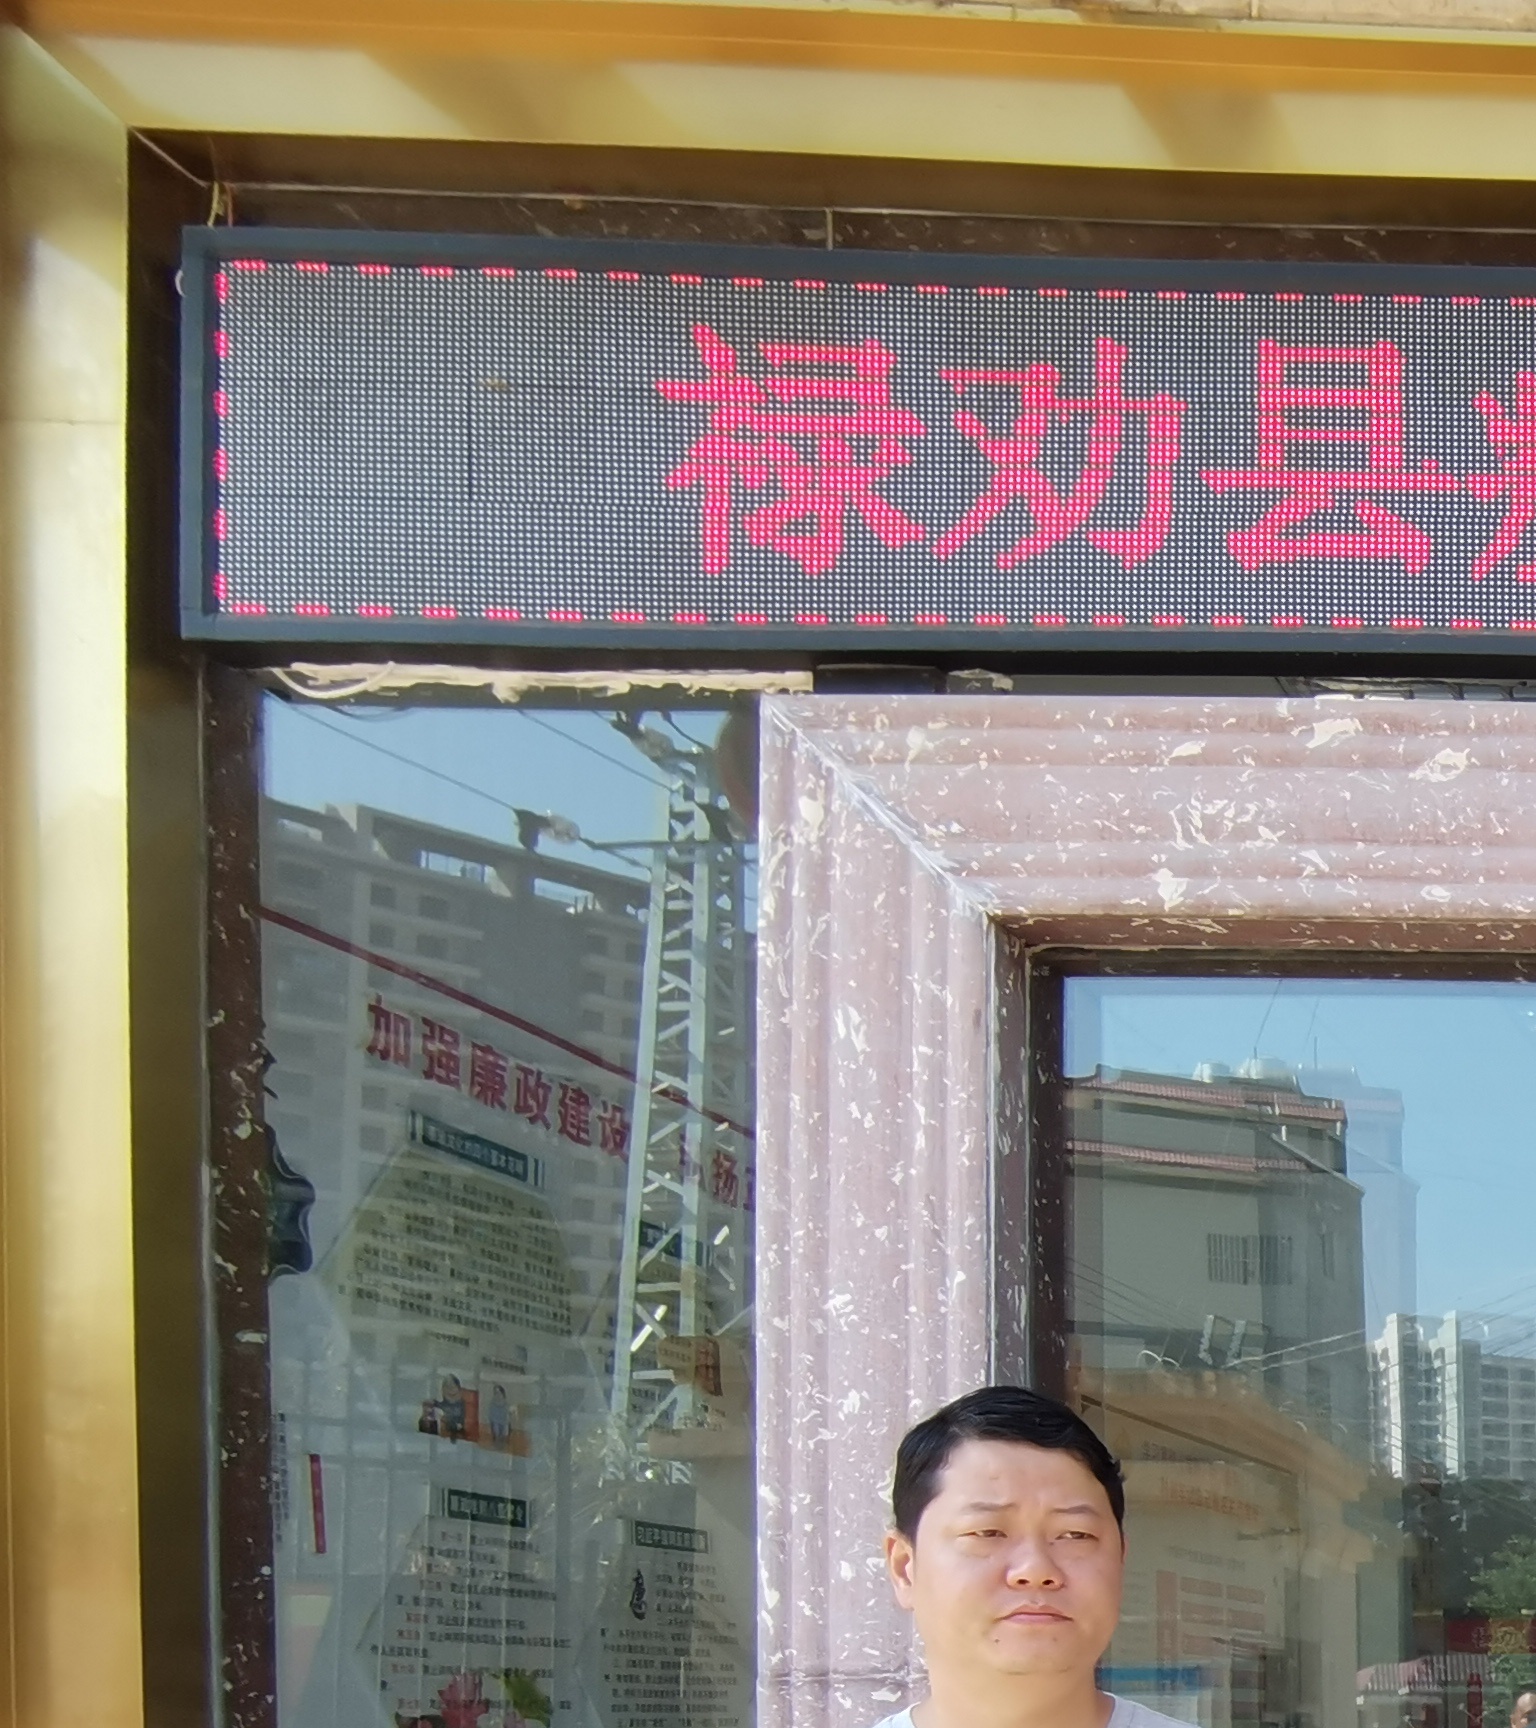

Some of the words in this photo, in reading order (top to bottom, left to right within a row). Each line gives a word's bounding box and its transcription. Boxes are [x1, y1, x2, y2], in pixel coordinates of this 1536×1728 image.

[366, 994, 629, 1164] 加强廉政建设
